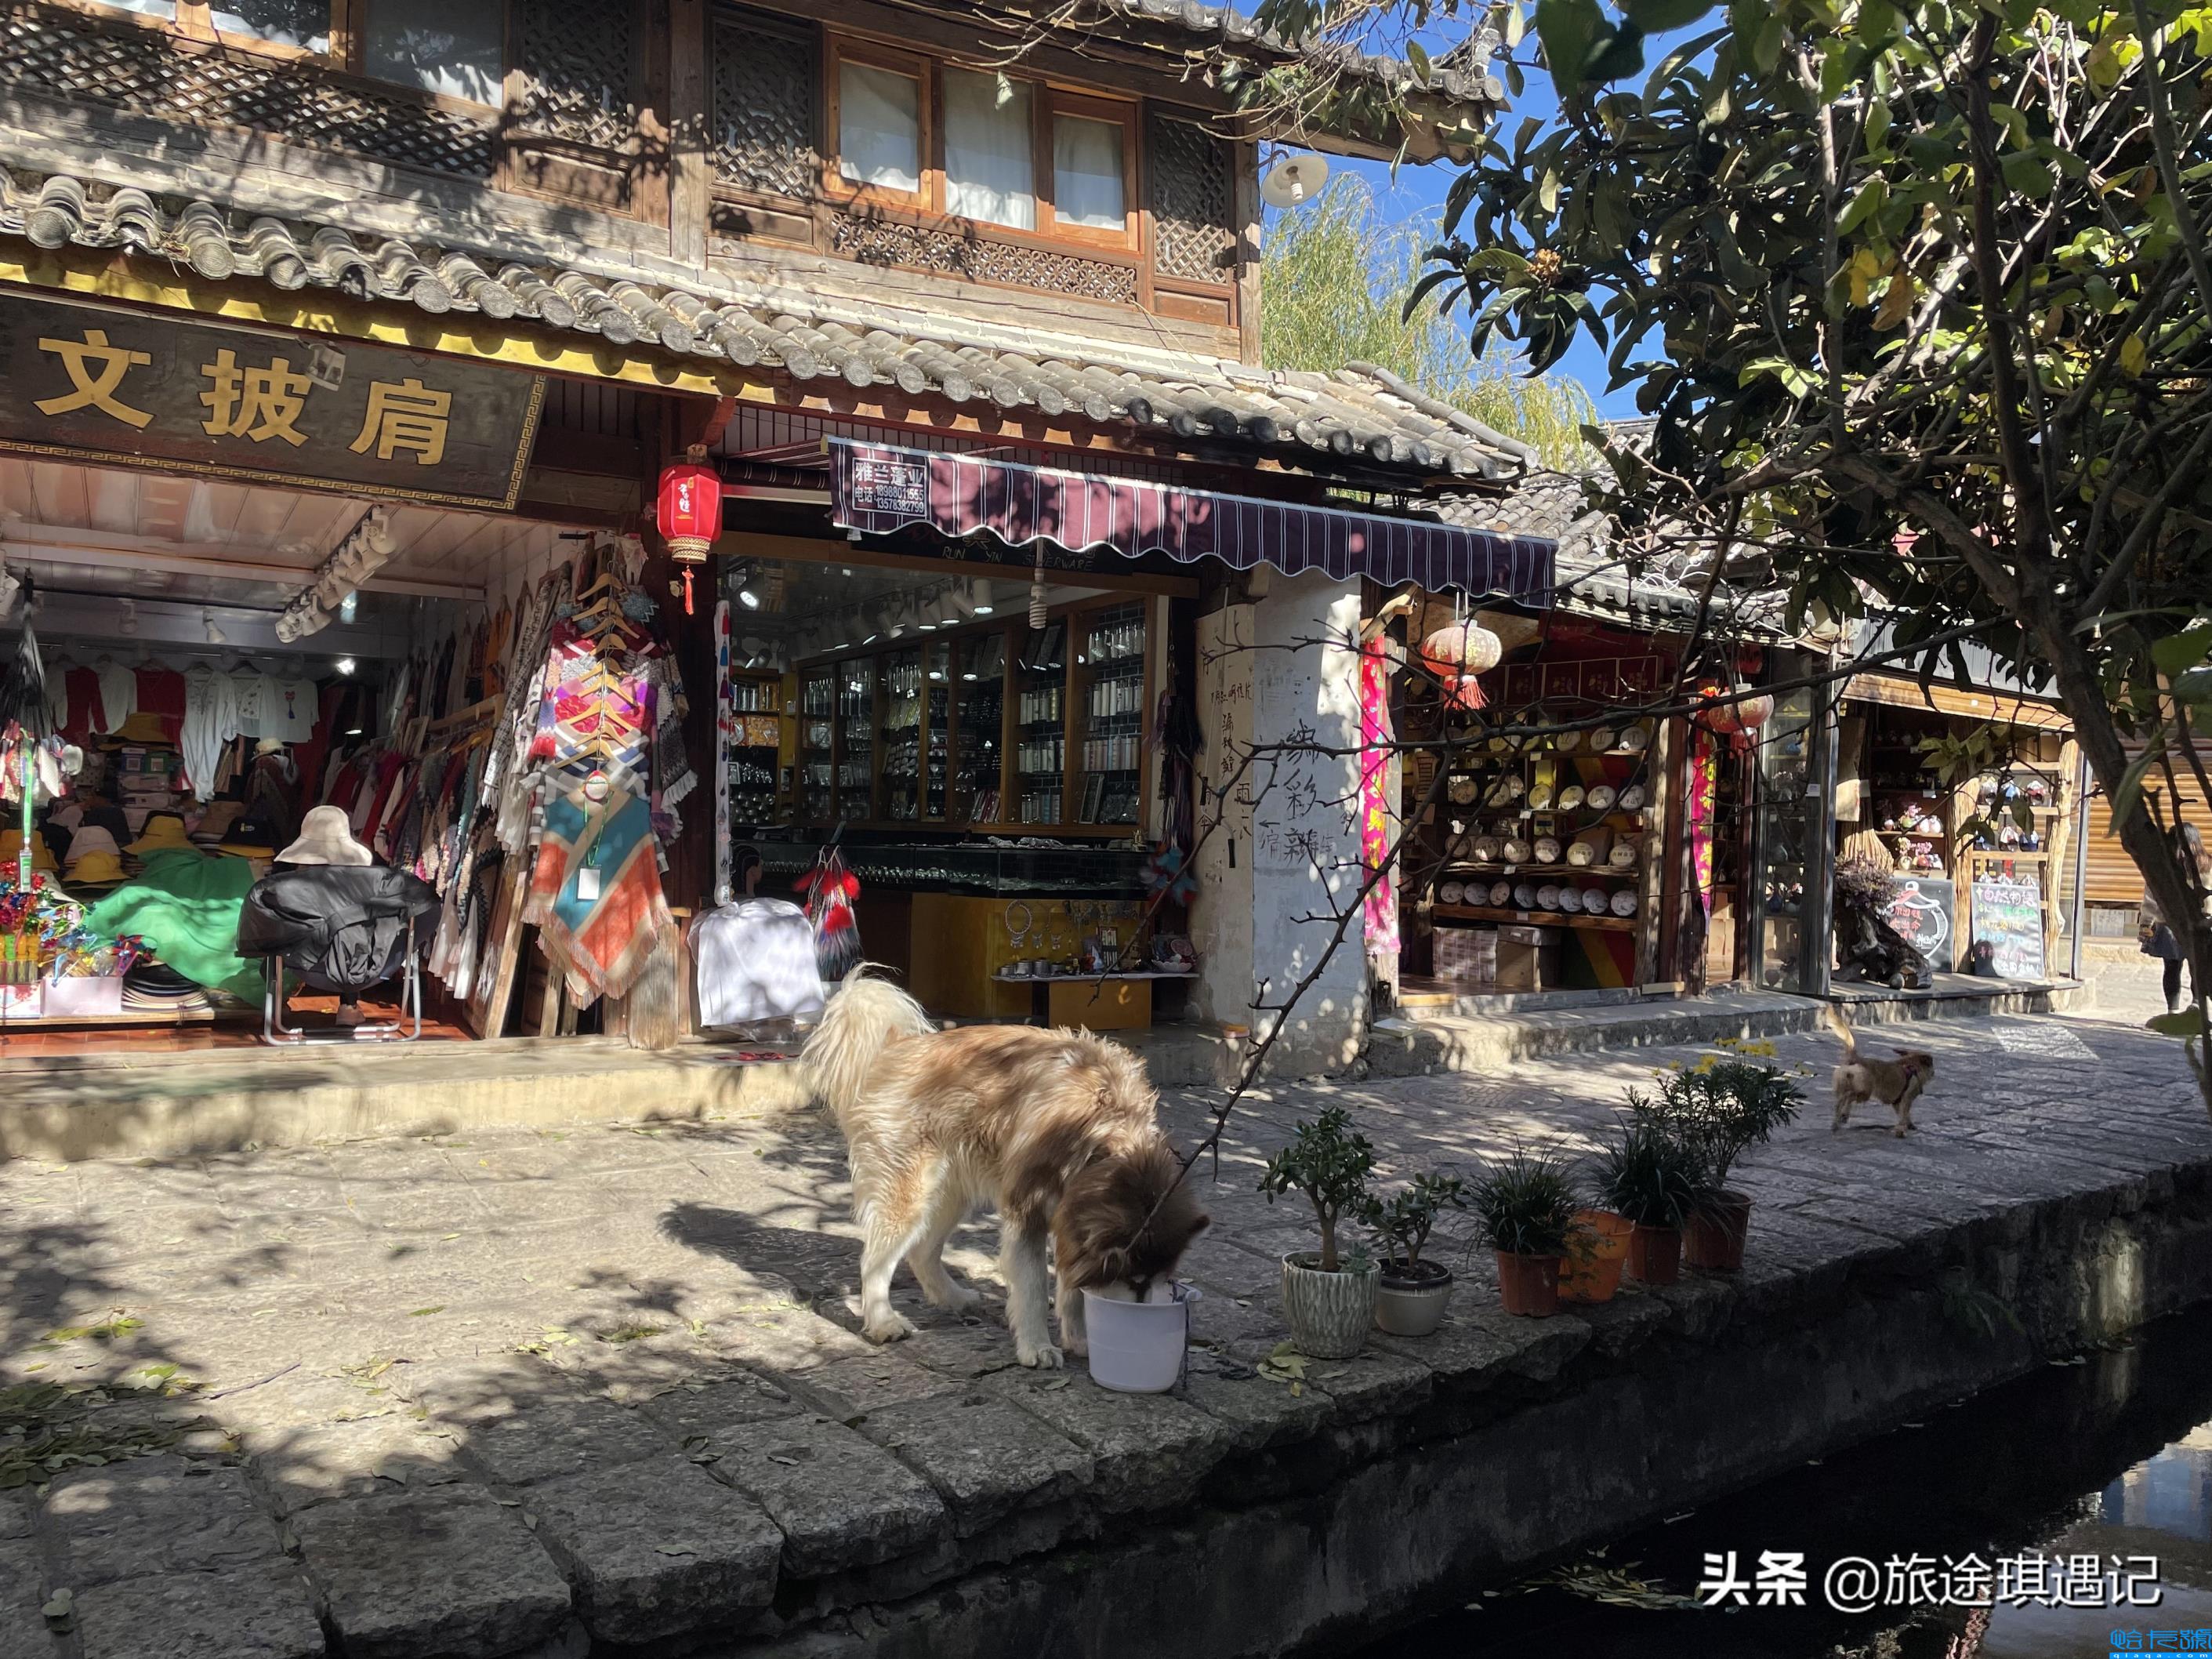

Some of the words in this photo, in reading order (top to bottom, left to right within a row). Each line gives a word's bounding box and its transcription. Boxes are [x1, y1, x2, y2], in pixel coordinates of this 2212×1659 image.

[33, 329, 453, 466] 文披肩
[855, 462, 924, 488] 雅兰蓬业
[875, 485, 924, 501] 18988011555
[876, 497, 924, 514] 13578382799
[942, 546, 966, 561] RUN
[985, 550, 1003, 563] YIN
[1022, 554, 1093, 572] SIERWARE
